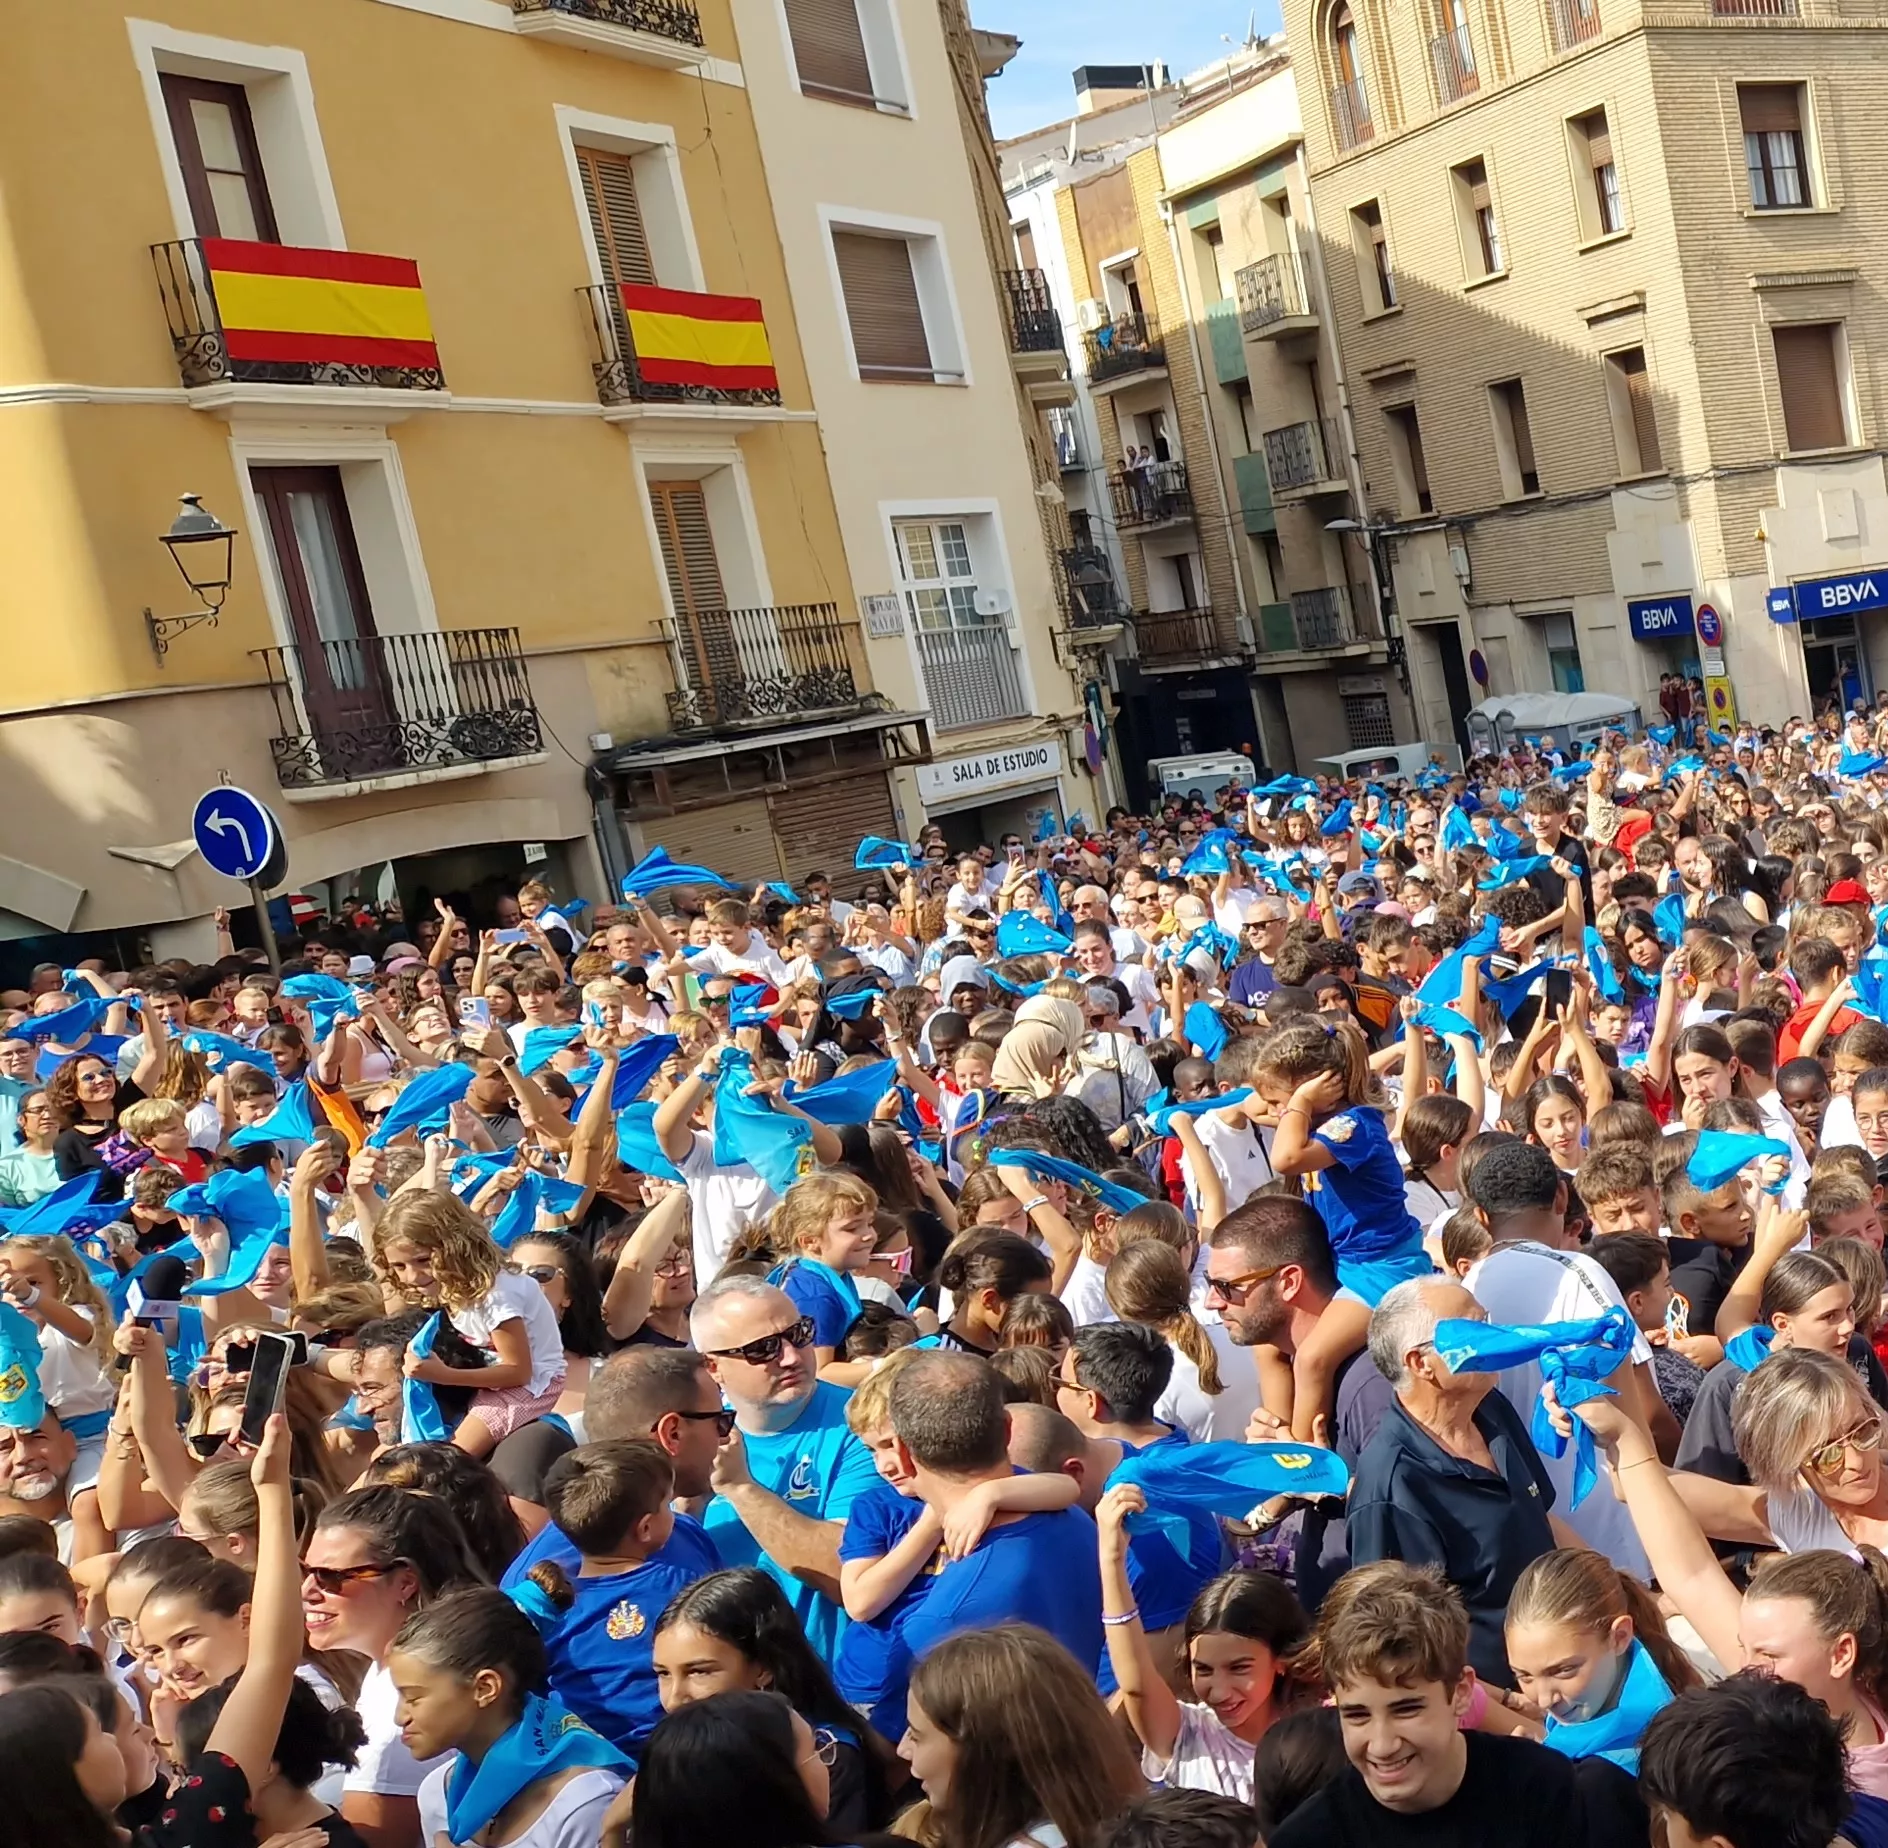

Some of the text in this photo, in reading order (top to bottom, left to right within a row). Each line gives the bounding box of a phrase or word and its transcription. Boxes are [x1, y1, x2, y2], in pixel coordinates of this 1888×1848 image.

[1772, 599, 1791, 612] BBVA
[1820, 578, 1879, 608] BBVA
[1642, 605, 1678, 630] BBVA
[952, 748, 1048, 782] SALA DE ESTUDIO
